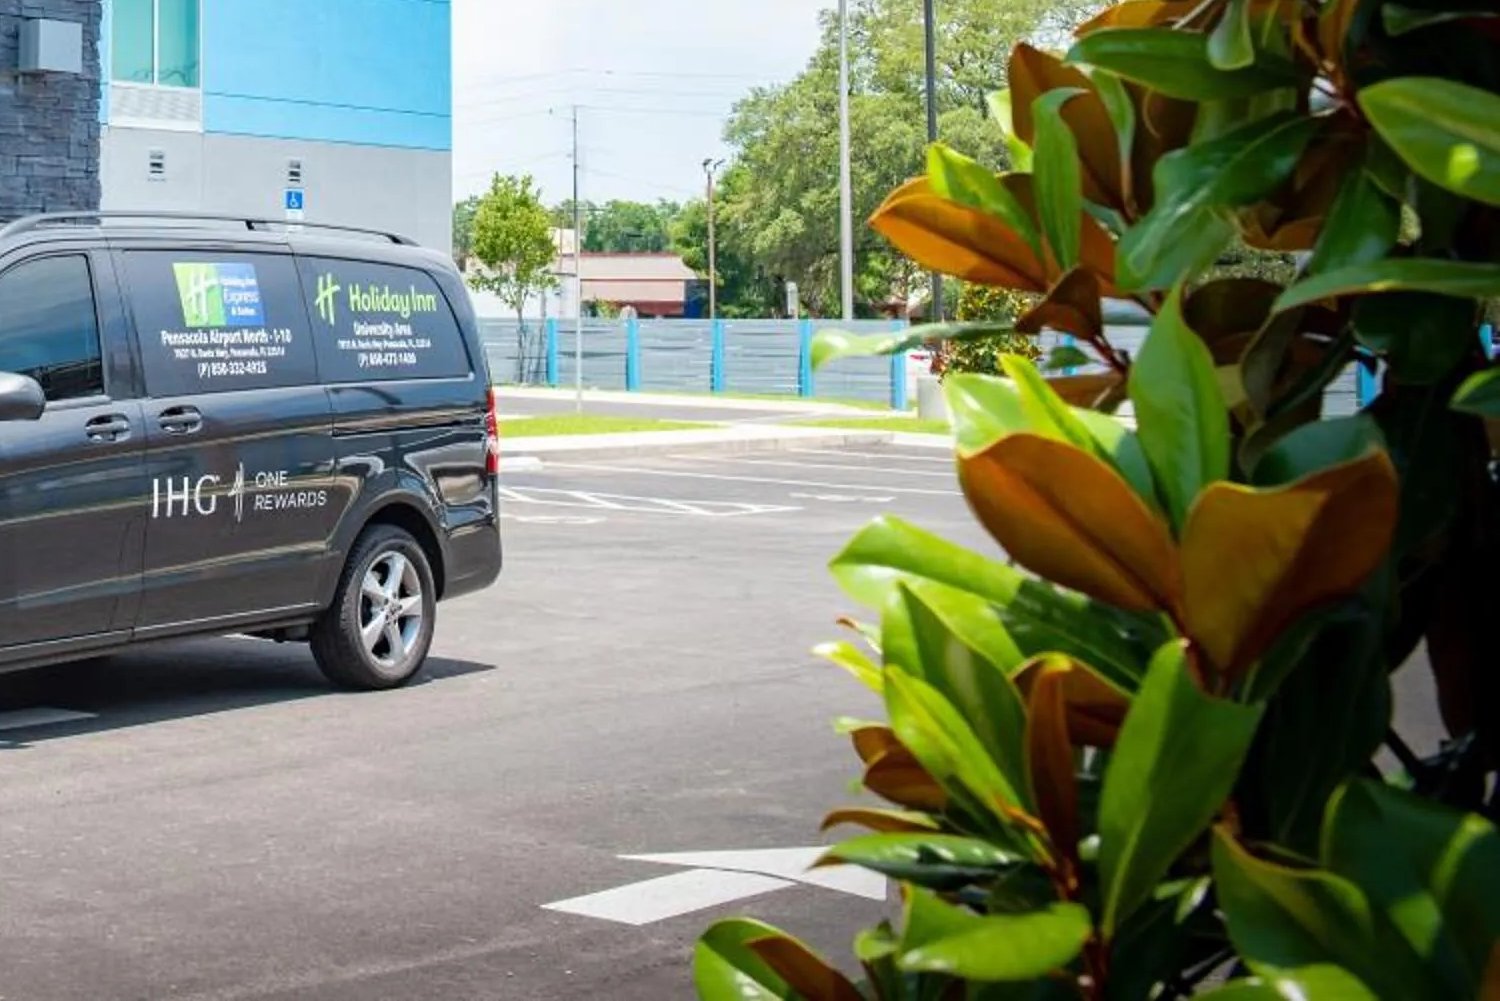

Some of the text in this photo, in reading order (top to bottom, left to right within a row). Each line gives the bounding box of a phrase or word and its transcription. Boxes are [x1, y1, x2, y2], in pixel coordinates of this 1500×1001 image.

[224, 289, 260, 304] Express
[349, 283, 437, 319] Holiday Inn
[160, 330, 208, 346] Pensacola
[209, 329, 242, 347] Airport
[243, 328, 268, 343] North
[353, 321, 393, 339] University
[255, 471, 289, 488] ONE
[152, 474, 218, 519] IHG
[254, 490, 327, 511] REWARDS
